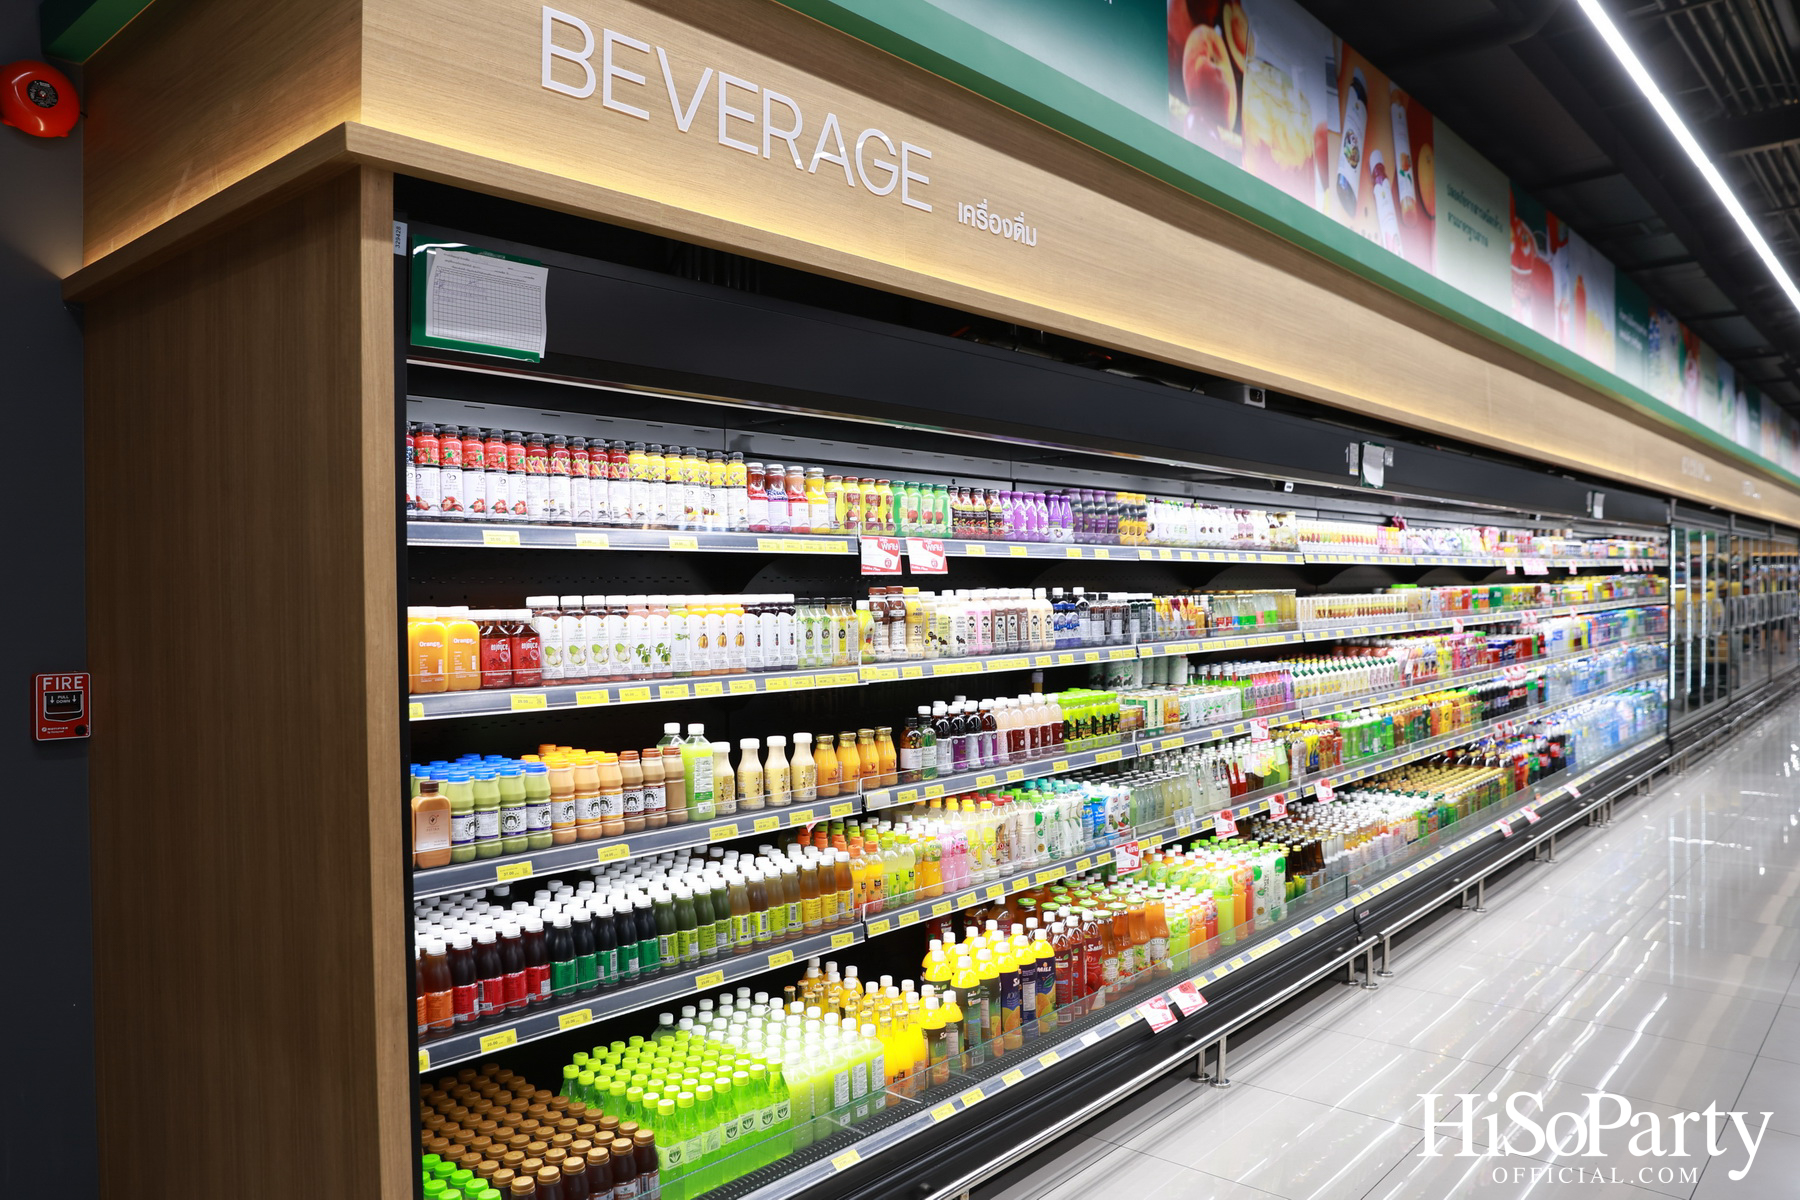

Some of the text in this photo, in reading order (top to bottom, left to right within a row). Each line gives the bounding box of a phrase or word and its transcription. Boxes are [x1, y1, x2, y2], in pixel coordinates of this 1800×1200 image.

[541, 5, 933, 213] BEVERAGE
[957, 198, 1037, 248] เครื่องดื่ม
[453, 637, 473, 645] Orange
[43, 676, 84, 690] FIRE
